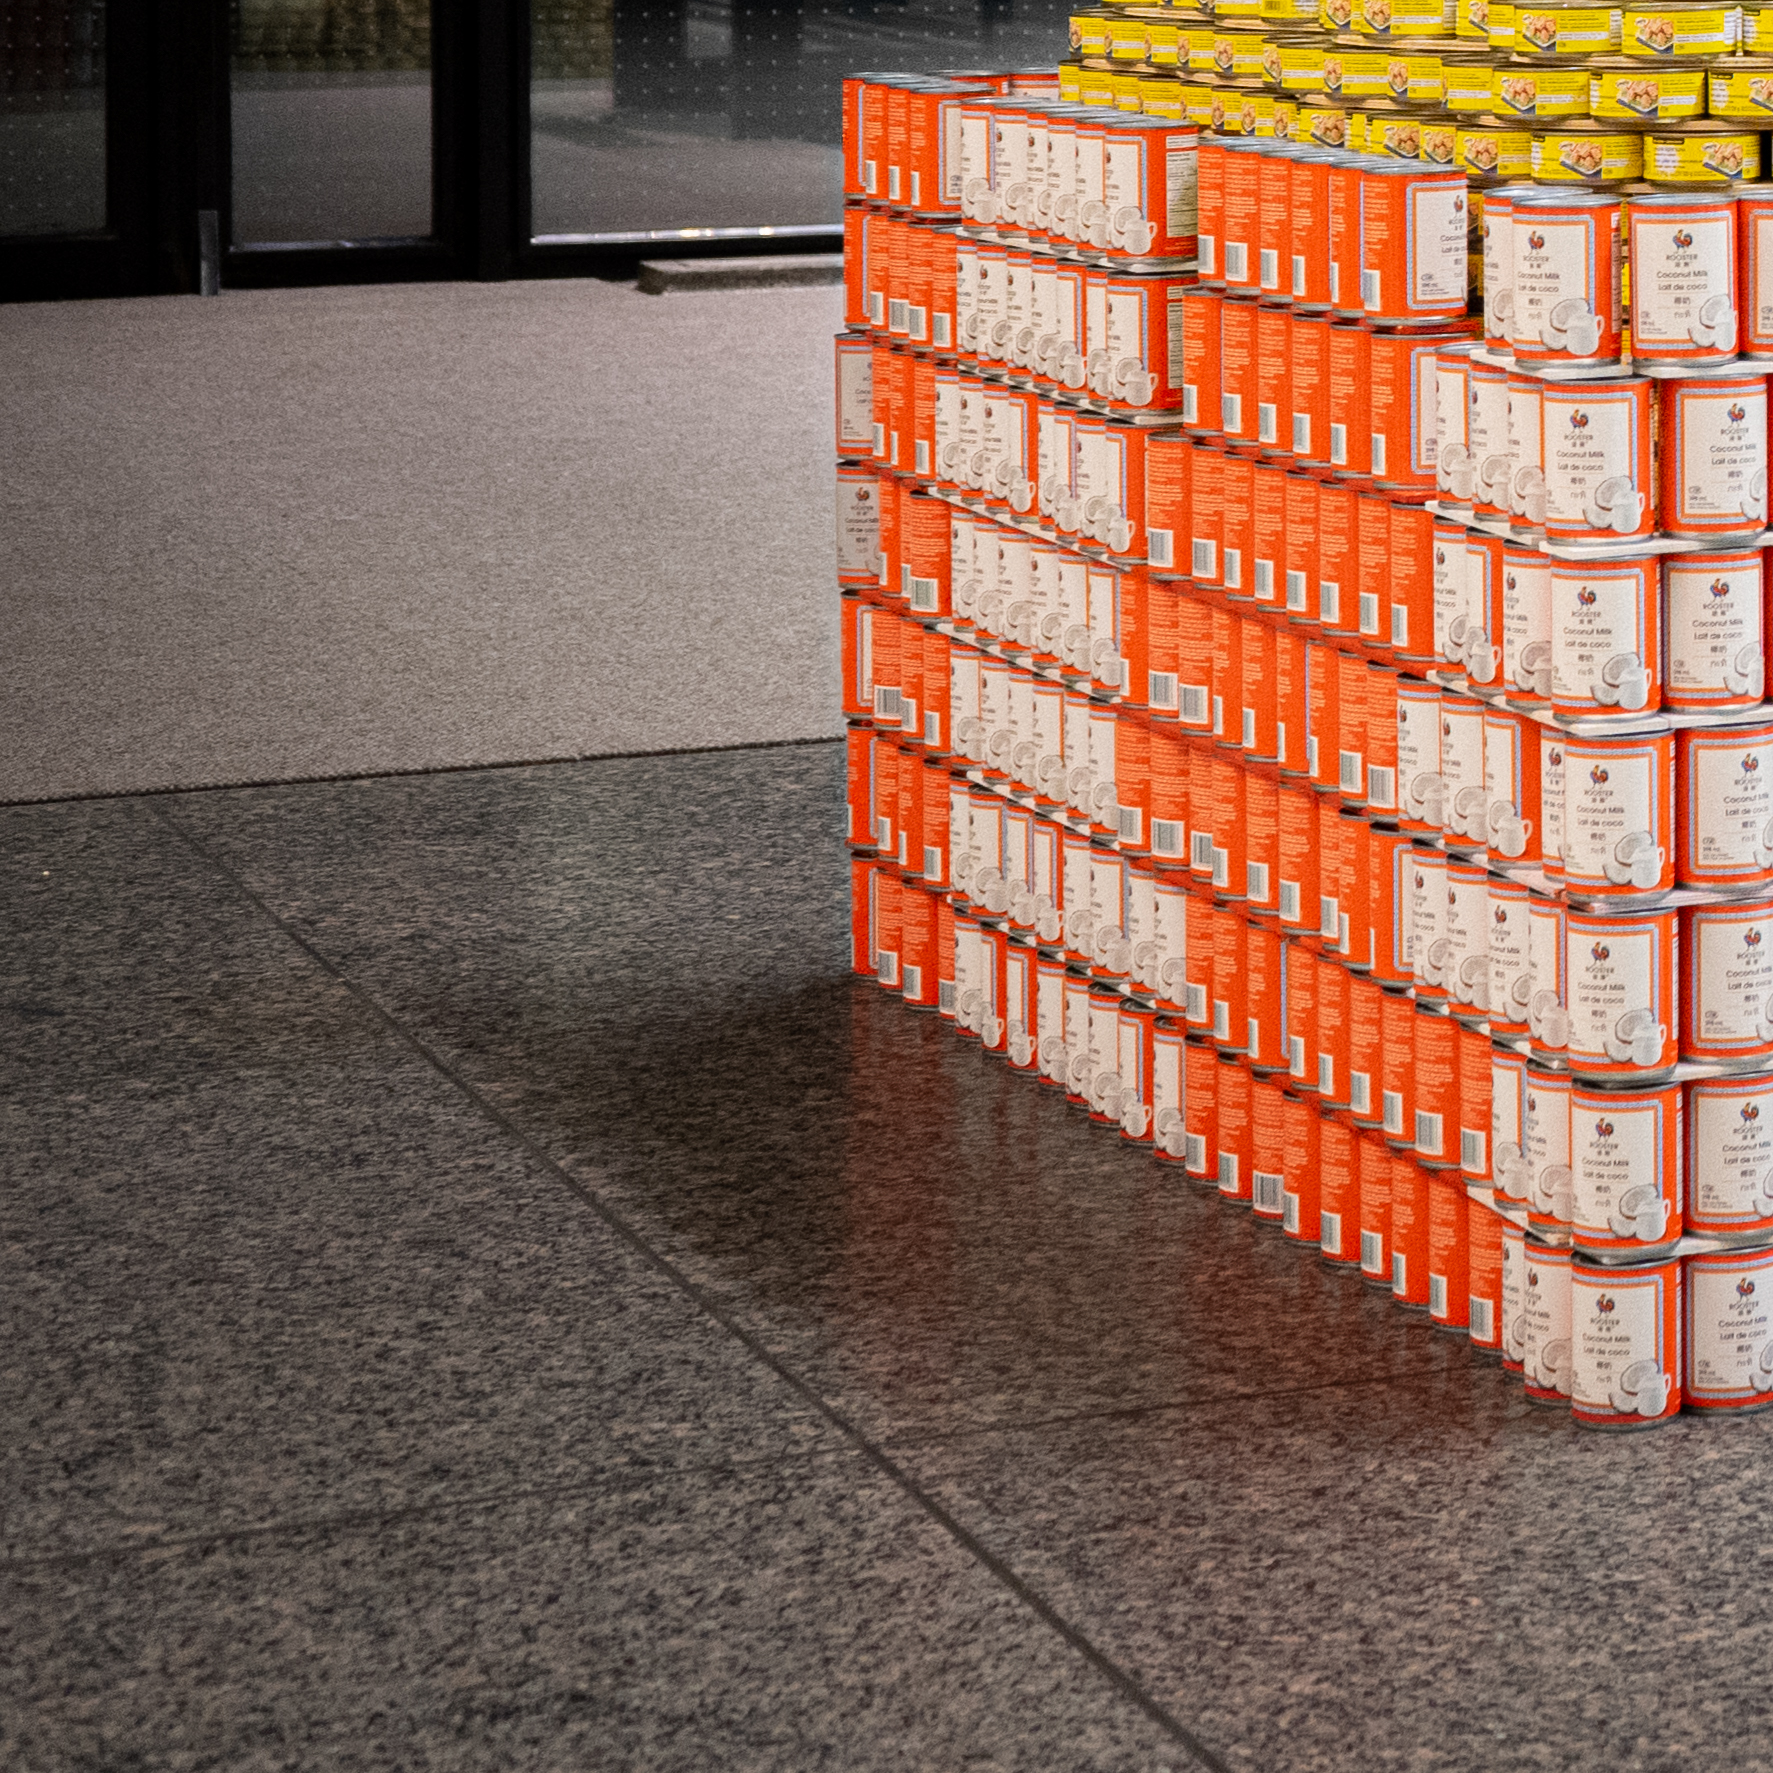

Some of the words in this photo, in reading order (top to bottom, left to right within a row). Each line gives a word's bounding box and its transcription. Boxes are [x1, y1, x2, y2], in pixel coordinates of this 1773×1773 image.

[1692, 619, 1727, 627] Coconut
[1563, 627, 1594, 635] Coconut
[1693, 632, 1708, 640] Lait
